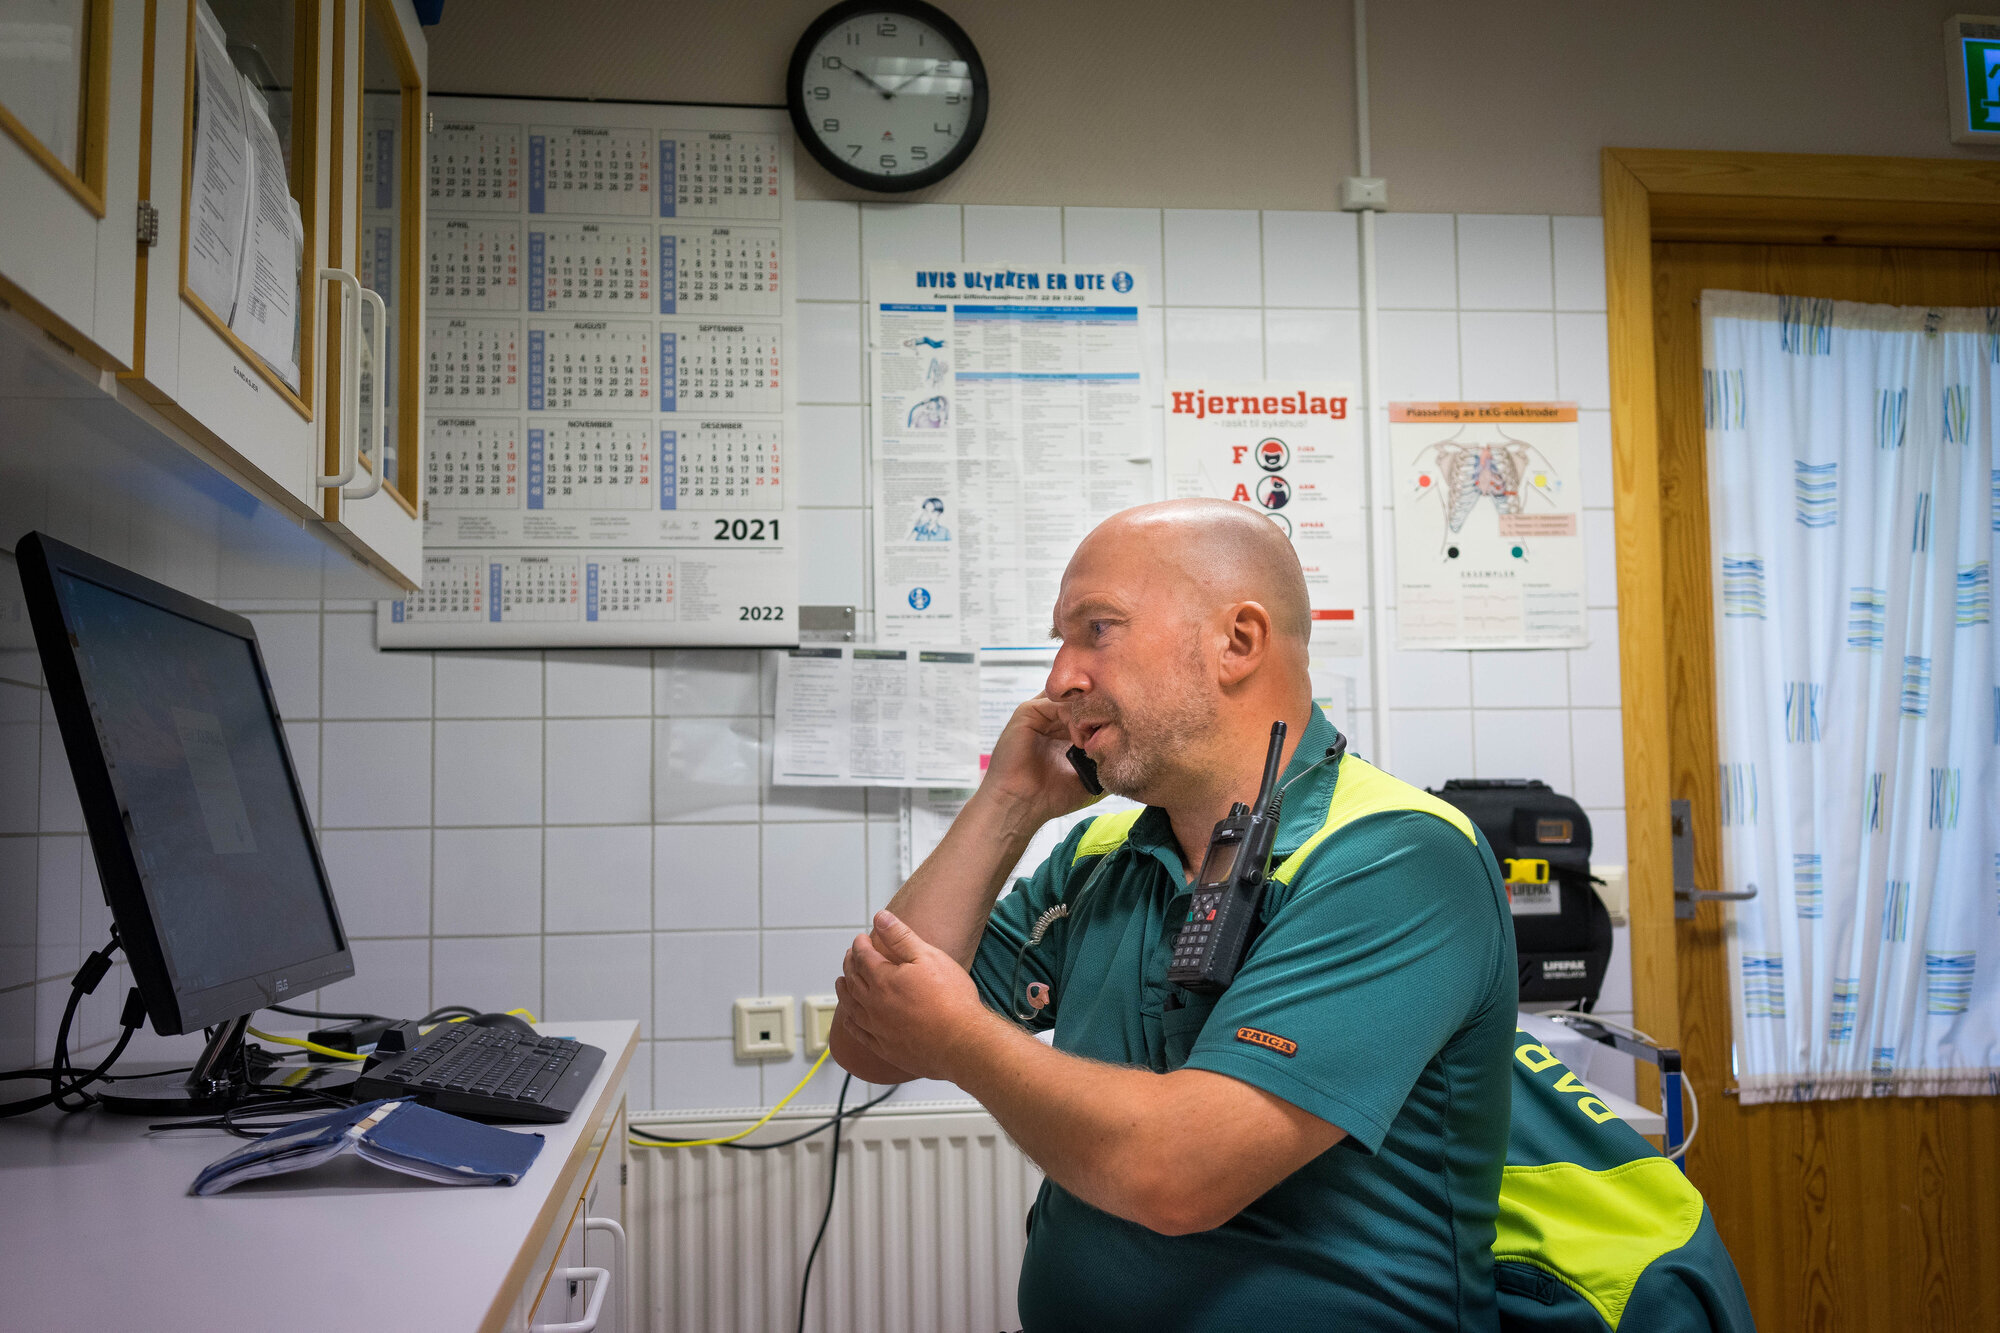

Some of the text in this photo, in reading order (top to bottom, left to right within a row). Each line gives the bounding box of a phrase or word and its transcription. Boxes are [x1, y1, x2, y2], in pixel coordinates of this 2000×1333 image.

[877, 23, 897, 37] 12
[847, 33, 860, 45] 11
[919, 34, 924, 46] 1
[822, 56, 842, 70] 10
[814, 86, 830, 100] 9
[946, 92, 960, 105] 3
[823, 118, 840, 132] 8
[934, 122, 952, 136] 4
[847, 144, 863, 158] 7
[911, 146, 928, 160] 5
[880, 154, 897, 168] 6
[916, 270, 1105, 291] HVIS ULYKKEN ER UTE
[574, 322, 607, 330] AUGUST
[699, 325, 744, 333] SEPTEMBER
[1171, 389, 1348, 419] Hjerneslag
[1406, 407, 1459, 419] Plassering
[1463, 409, 1475, 417] av
[437, 419, 475, 427] OKTOBER
[568, 420, 614, 428] NOVEMBER
[1232, 446, 1248, 464] F
[1232, 483, 1250, 501] A
[714, 518, 779, 541] 2021
[739, 606, 784, 621] 2022
[1543, 960, 1586, 971] LIFEPAK
[1240, 1029, 1292, 1052] TAIGA
[1514, 1026, 1621, 1125] PAR
